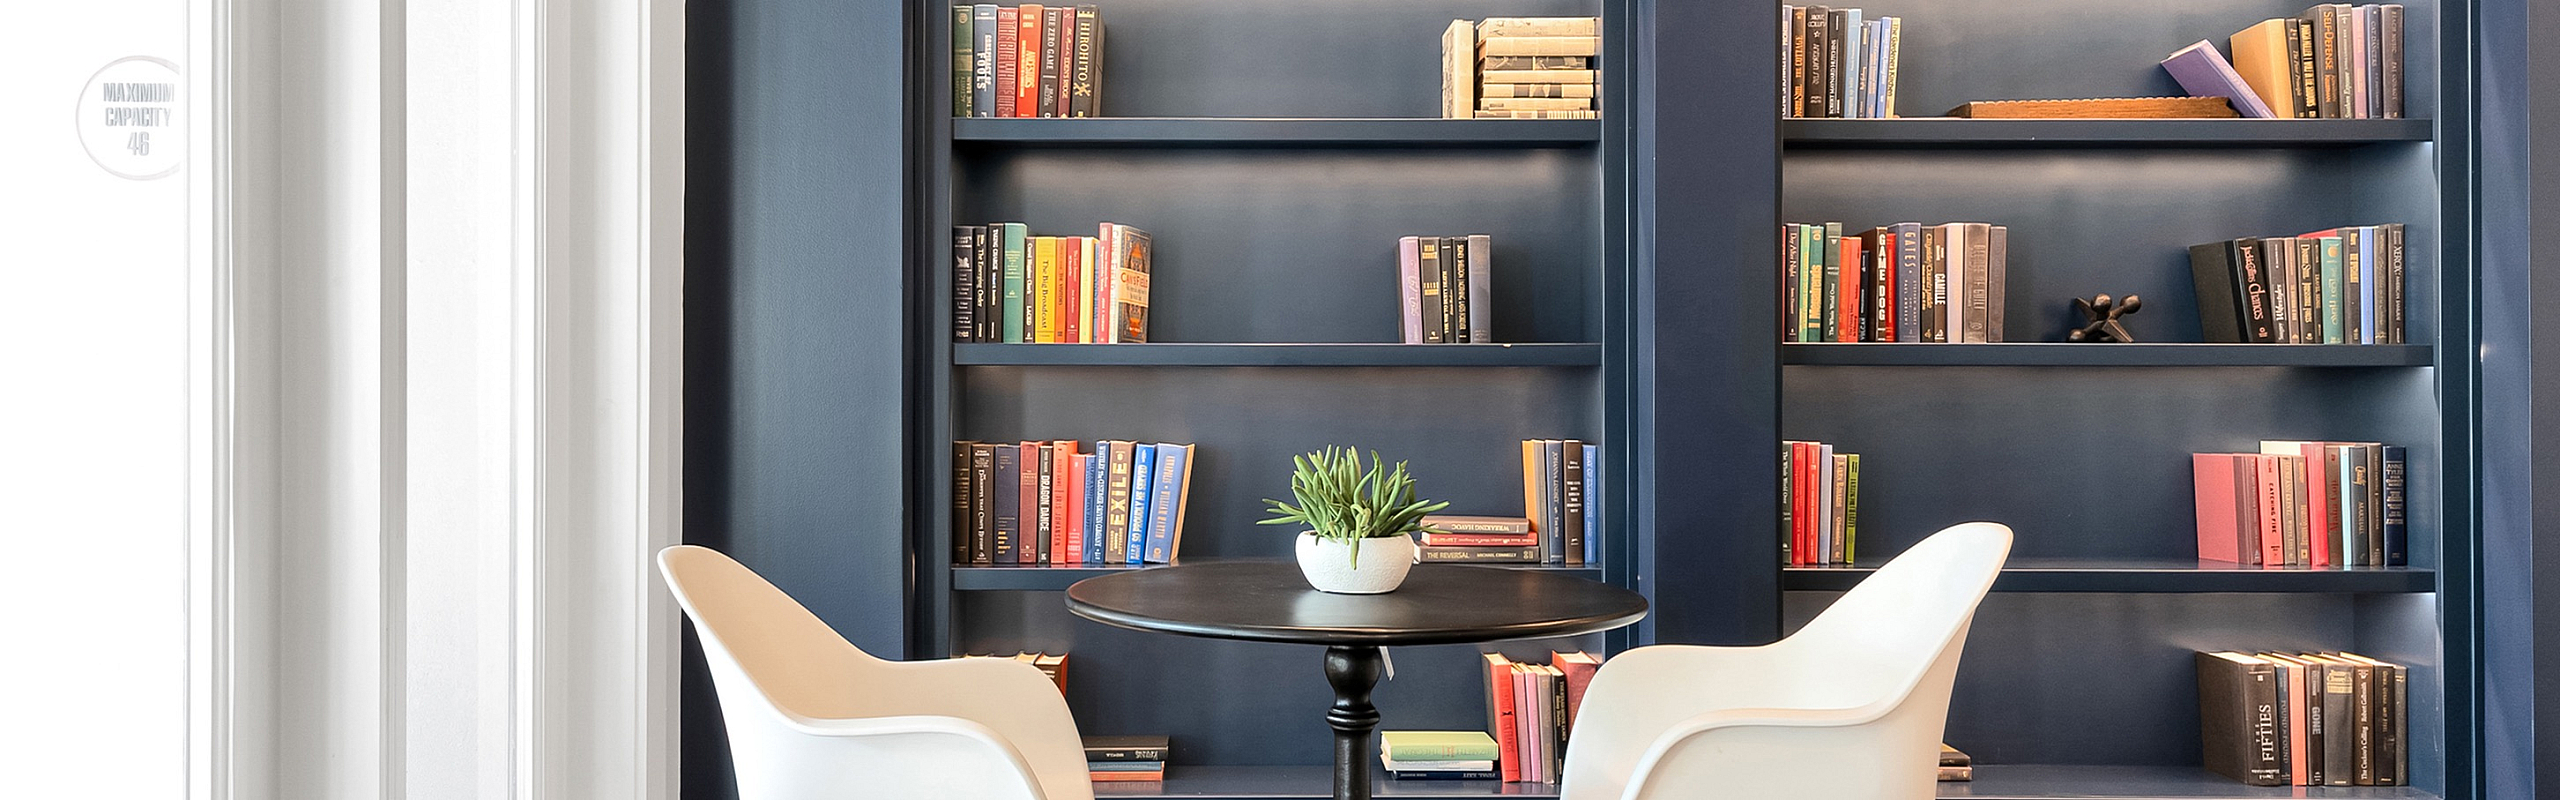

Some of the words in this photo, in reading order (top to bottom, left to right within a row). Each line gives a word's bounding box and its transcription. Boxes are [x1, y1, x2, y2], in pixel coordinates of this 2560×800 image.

[1048, 12, 1056, 26] THE
[999, 42, 1016, 60] BIG
[1047, 28, 1056, 47] ZERO
[1078, 22, 1090, 81] HIROHITO
[1794, 34, 1803, 66] COTTAGE
[2324, 11, 2334, 71] SELF-DEFENSE
[976, 52, 986, 91] FOOLS
[1046, 49, 1054, 70] GAME
[103, 83, 175, 102] MAXIMUM
[105, 107, 171, 127] CAPACITY
[127, 131, 150, 156] 46
[1878, 234, 1886, 281] GAME
[1904, 232, 1916, 267] GATES
[1935, 273, 1946, 305] CAMILLE
[2248, 283, 2266, 320] Chances
[2328, 278, 2338, 298] LOST
[2329, 300, 2339, 325] HERO
[1041, 475, 1050, 505] DRAGON
[1110, 462, 1127, 525] EXILE
[1040, 507, 1049, 531] DANCE
[1133, 501, 1144, 532] PROUDLY
[2259, 704, 2274, 762] FIFTIES
[2312, 706, 2321, 735] GONE
